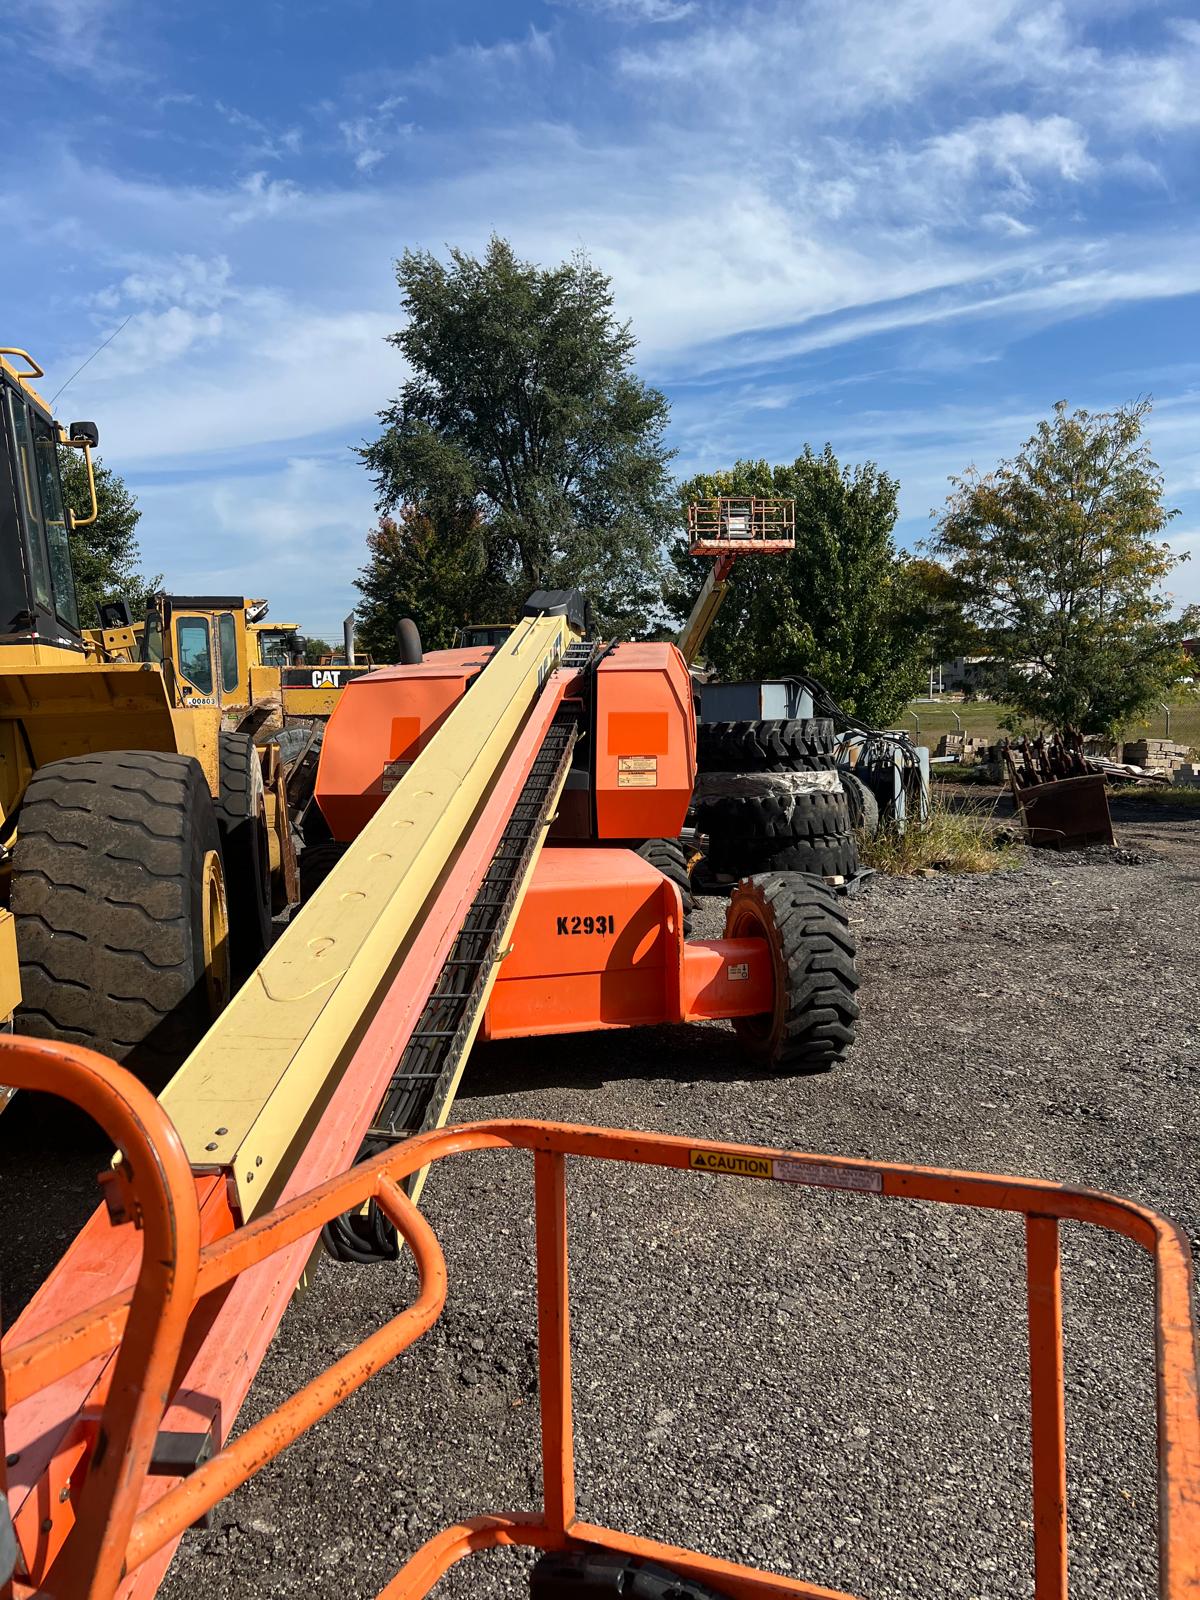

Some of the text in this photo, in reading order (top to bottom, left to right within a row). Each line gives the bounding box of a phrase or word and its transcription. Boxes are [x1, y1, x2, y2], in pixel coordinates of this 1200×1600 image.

[312, 671, 340, 688] CAT
[557, 915, 614, 935] K2931
[707, 1155, 769, 1174] CAUTION
